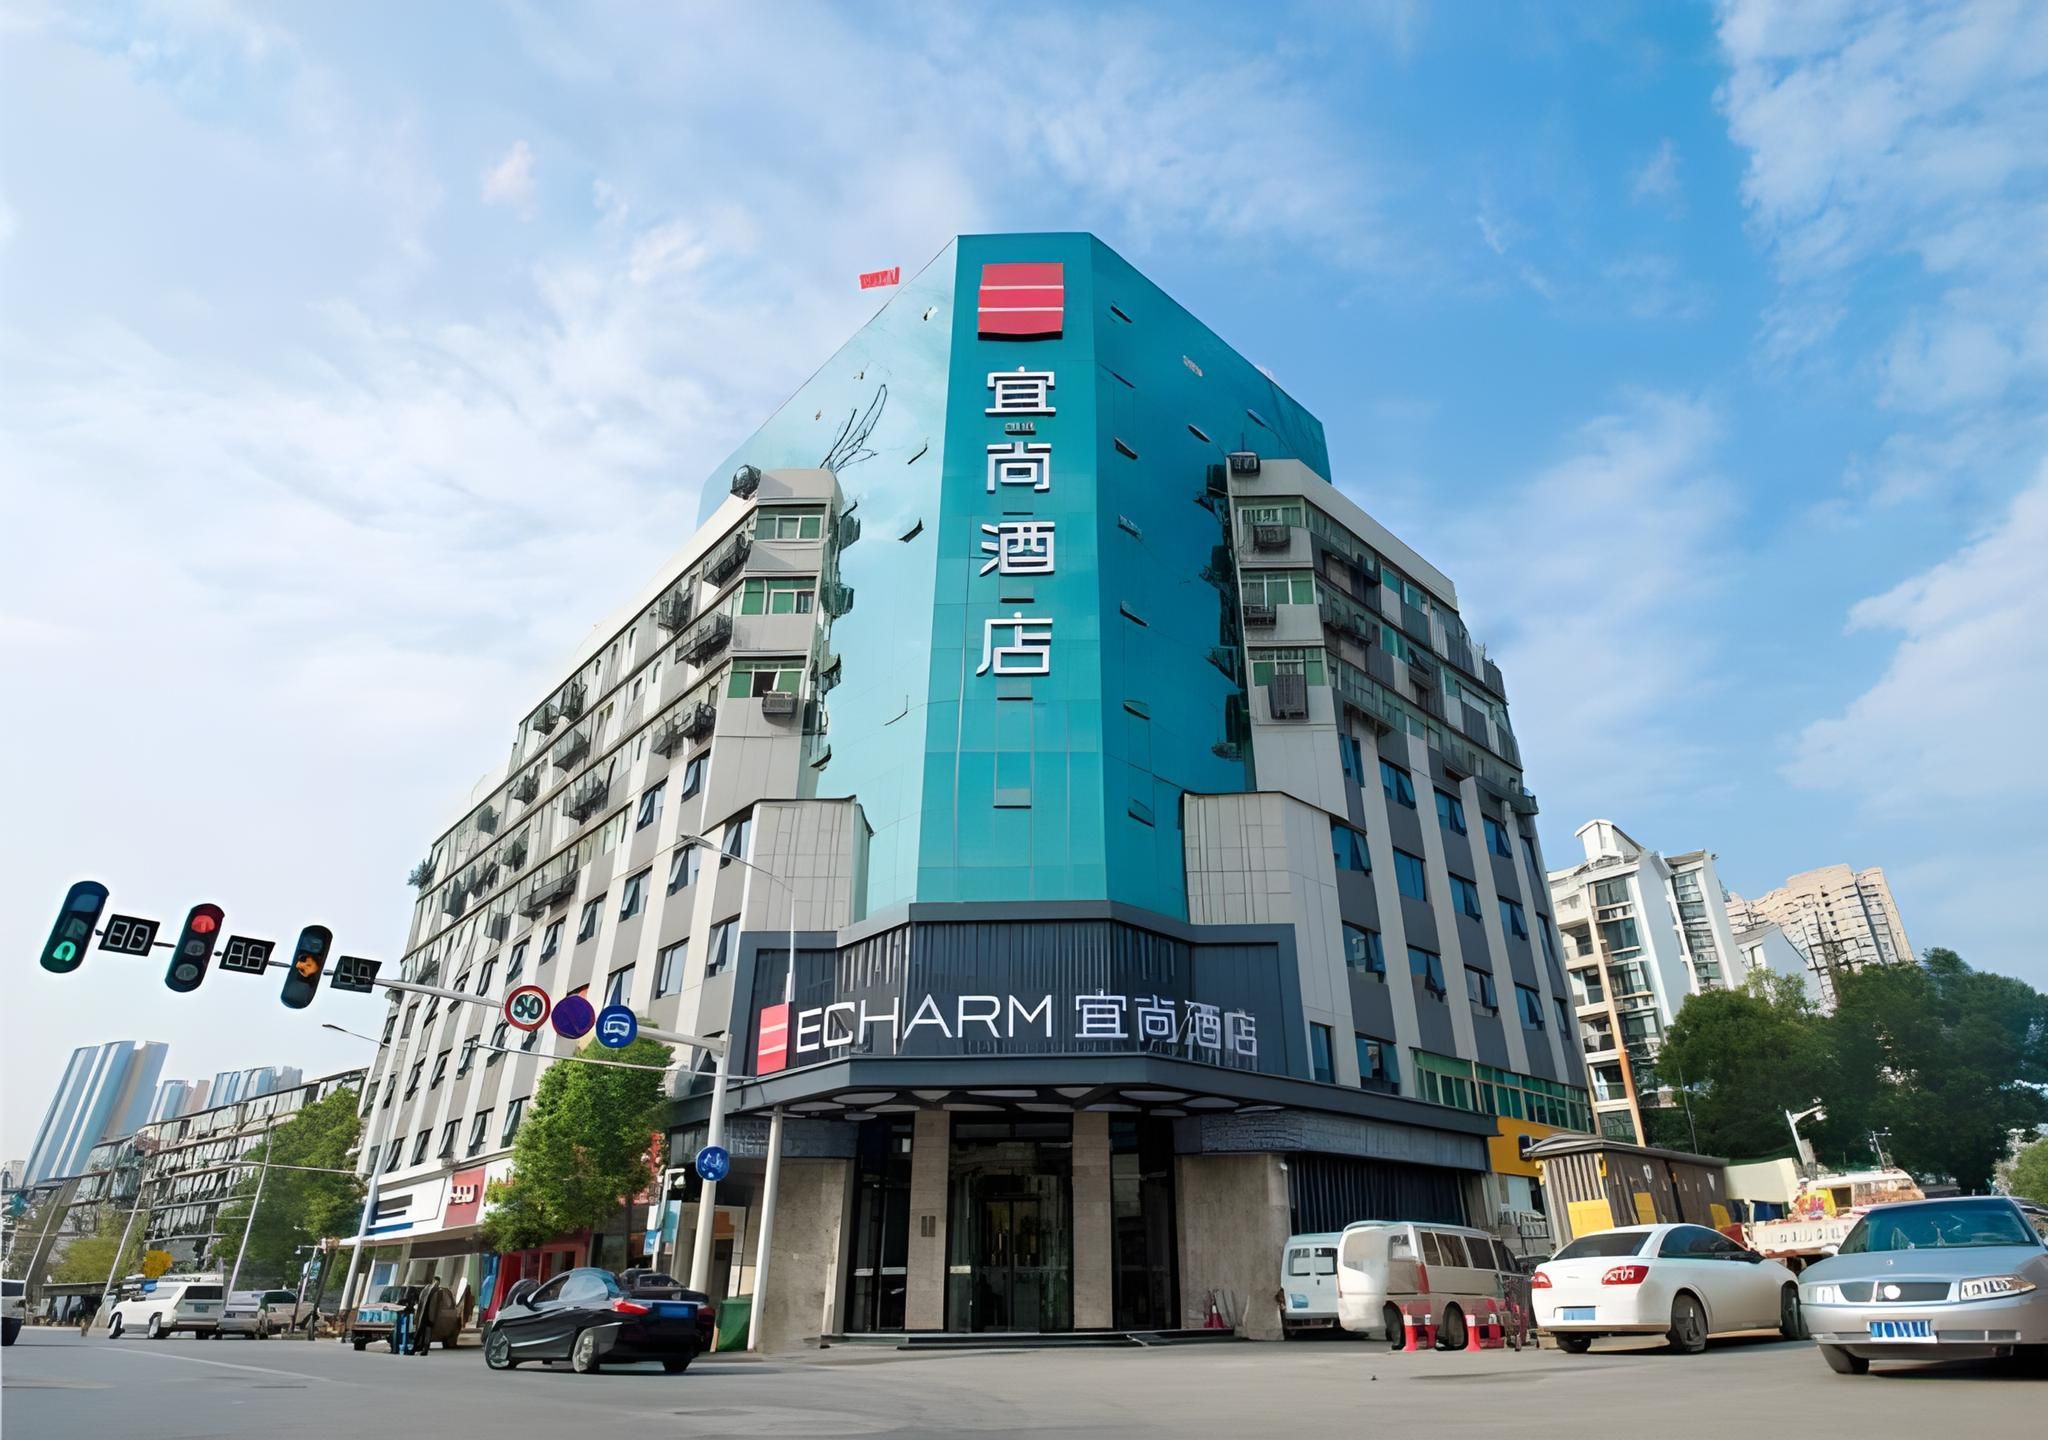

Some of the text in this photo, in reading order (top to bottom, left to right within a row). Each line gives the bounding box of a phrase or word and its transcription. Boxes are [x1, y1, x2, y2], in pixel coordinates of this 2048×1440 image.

[976, 366, 1056, 676] 宜尚酒店
[796, 988, 1257, 1057] ECHARM 宜尚酒店
